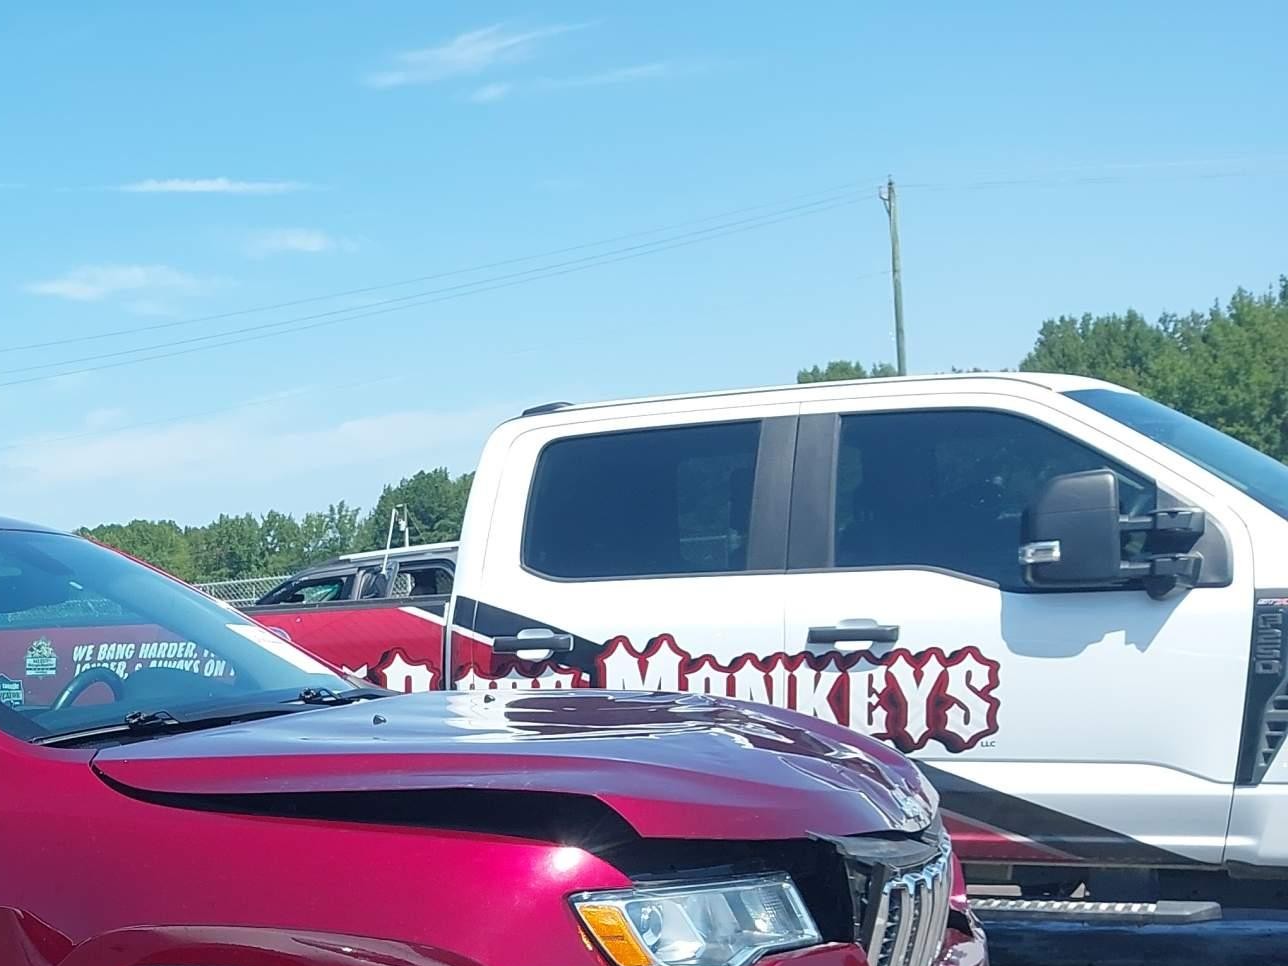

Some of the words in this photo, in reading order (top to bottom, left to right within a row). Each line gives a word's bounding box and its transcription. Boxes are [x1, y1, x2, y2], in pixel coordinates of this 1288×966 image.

[73, 645, 94, 661] WE
[97, 643, 135, 660] BANG
[138, 642, 197, 659] HARDER,
[203, 660, 226, 677] ON
